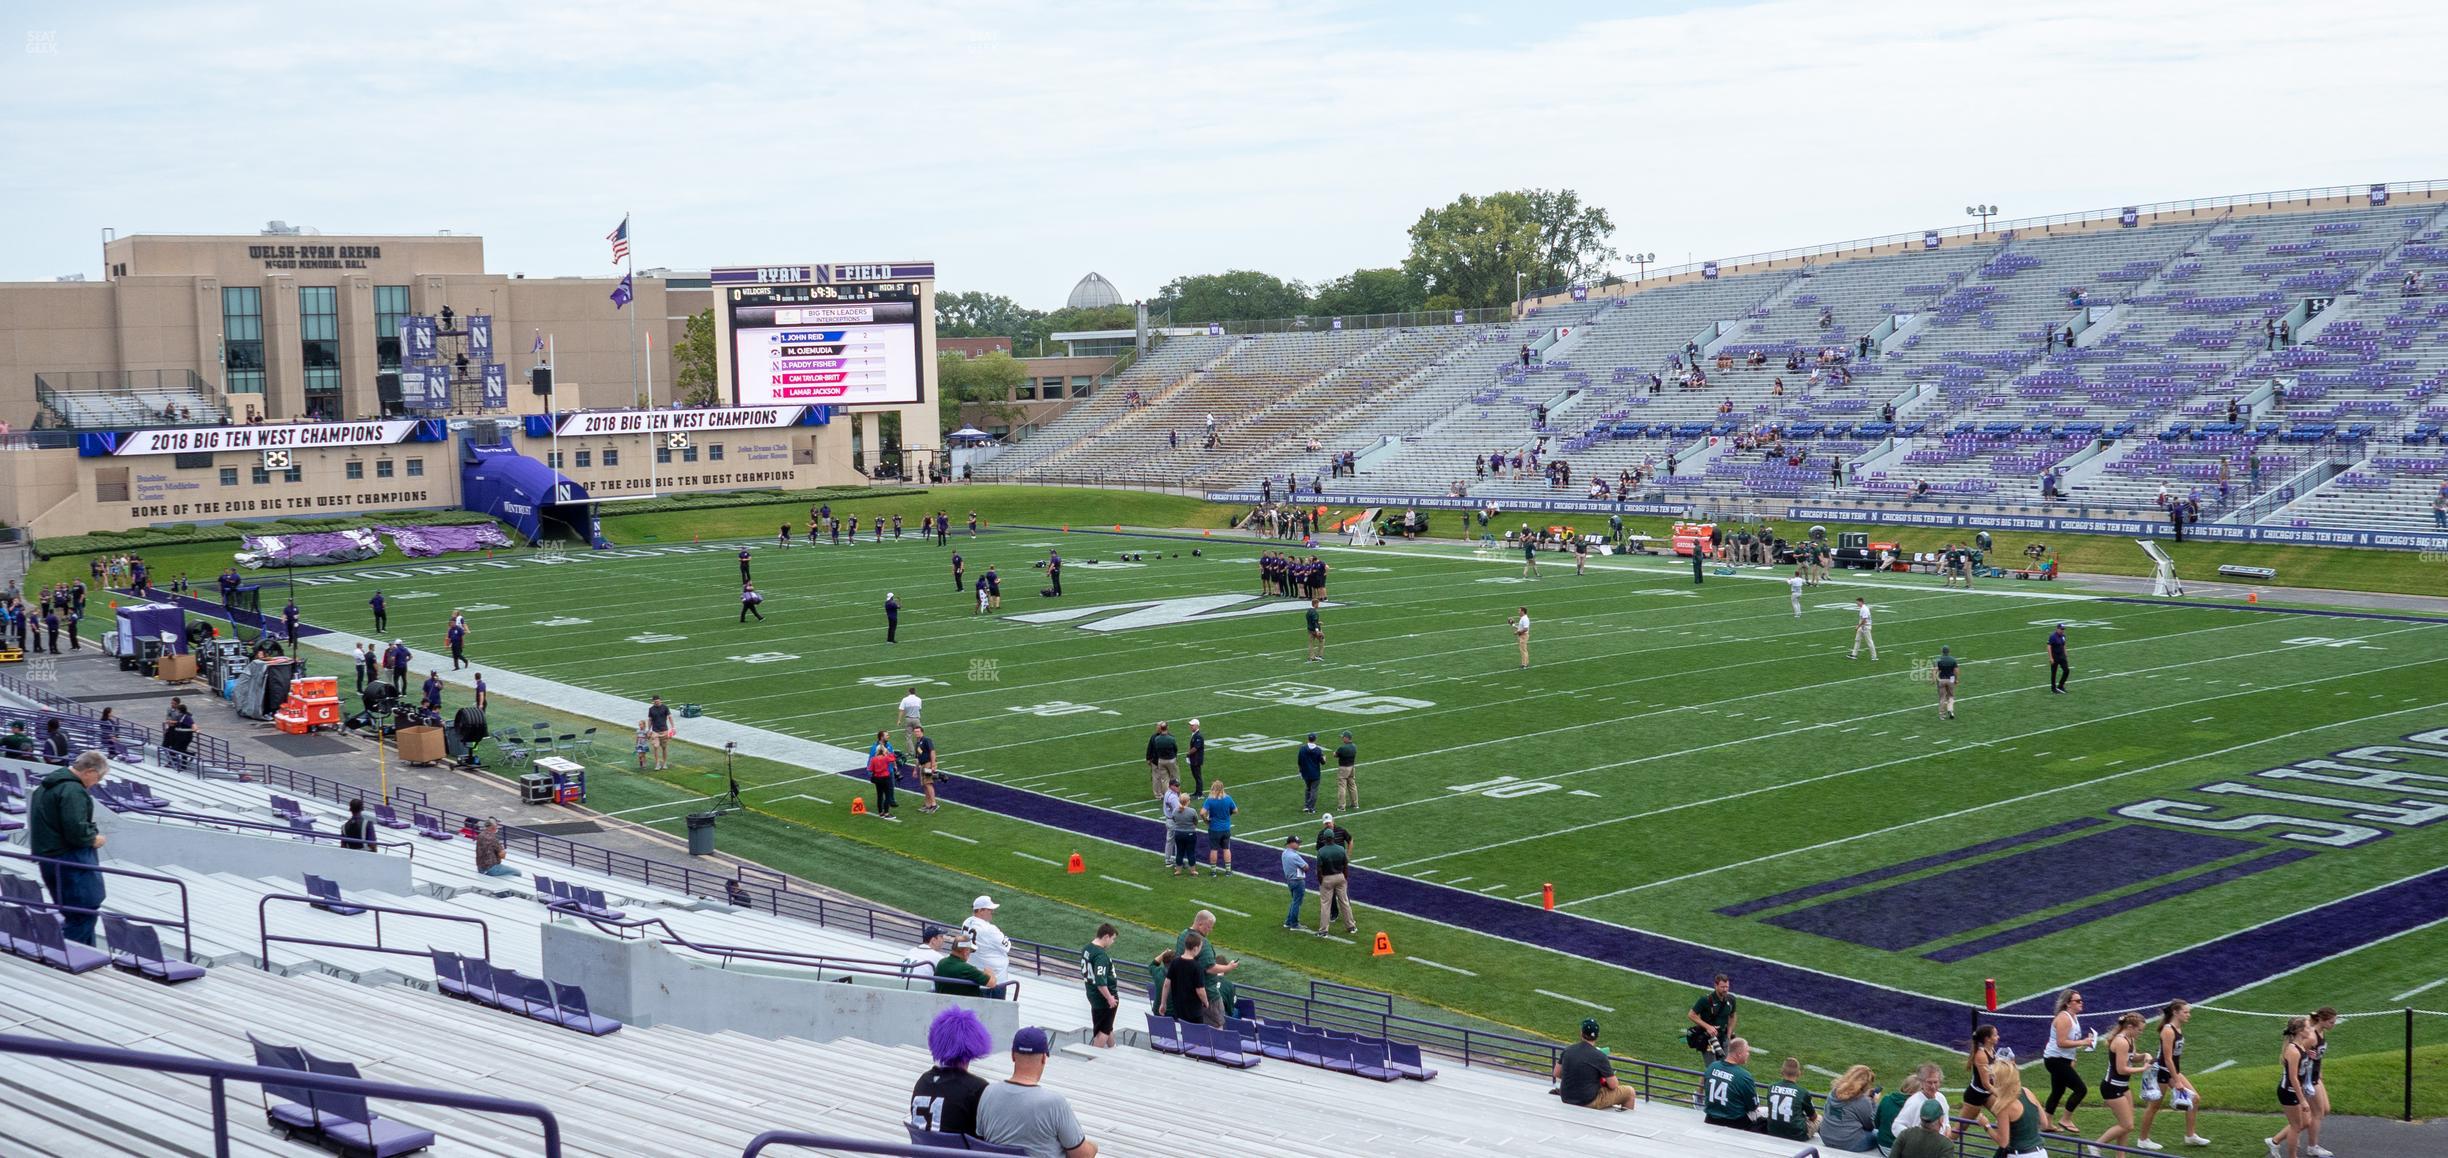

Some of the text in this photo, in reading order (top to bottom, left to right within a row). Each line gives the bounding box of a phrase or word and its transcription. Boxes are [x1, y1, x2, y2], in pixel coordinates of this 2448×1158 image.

[2371, 191, 2385, 200] 108
[2124, 213, 2136, 222] 107
[248, 246, 381, 259] WELSH-RYAN ARENA
[299, 260, 343, 269] MEMORIAL
[345, 260, 368, 269] HALL
[757, 267, 801, 283] RYAN
[817, 265, 829, 284] N
[845, 265, 892, 281] FIELD
[734, 289, 741, 300] 0
[912, 284, 920, 295] 0
[1574, 290, 1585, 298] 104
[415, 327, 431, 349] N
[472, 326, 488, 348] N
[813, 360, 837, 368] FISHER
[772, 375, 781, 384] N
[430, 376, 446, 399] N
[487, 376, 502, 398] N
[773, 389, 782, 398] N
[585, 410, 778, 432] 2018 BIG TEN WEST CHAMPIONS
[151, 425, 384, 451] 2018 BIG TEN WEST CHAMPIONS
[670, 433, 687, 447] 25
[266, 451, 289, 467] 25
[137, 482, 200, 492] Sports Medicine
[582, 471, 795, 491] OF THE 2018 BIG TEN WEST CHAMPIONS
[559, 484, 571, 501] N
[131, 491, 427, 518] HOME OF THE 2018 BIG TEN WEST CHAMPIONS
[1799, 510, 1828, 519] CHICAGO'S
[1828, 511, 1838, 519] BIG
[1839, 511, 1850, 520] TEN
[1851, 512, 1867, 520] TEAM
[1882, 513, 1911, 522] CHICAGO'S
[1912, 514, 1923, 522] BIG
[1924, 514, 1935, 523] TEN
[1936, 515, 1953, 524] TEAM
[1969, 516, 2000, 526] CHICAGO'S
[2000, 517, 2012, 527] BIG
[2012, 518, 2025, 527] TEN
[2026, 518, 2044, 528] TEAM
[2060, 520, 2094, 531] CHICAGO'S
[2094, 522, 2106, 531] BIG
[2106, 523, 2121, 532] TEN
[2121, 523, 2141, 533] TEAM
[2195, 526, 2208, 536] BIG
[2208, 527, 2223, 536] TEN
[2224, 528, 2244, 537] TEAM
[2263, 529, 2301, 540] CHICAGO'S
[2301, 531, 2315, 541] BIG
[2316, 532, 2331, 542] TEN
[2332, 532, 2354, 543] TEAM
[2360, 533, 2368, 544] N
[2374, 534, 2416, 546] CHICAGO'S
[1001, 594, 1346, 632] N
[319, 707, 329, 718] G
[1005, 701, 1100, 716] 30
[1203, 733, 1303, 753] 20
[1446, 776, 1562, 798] 10
[853, 802, 864, 812] 20
[1072, 858, 1081, 866] 10
[1377, 937, 1387, 950] G
[1709, 1078, 1728, 1106] 14
[911, 1096, 945, 1132] 51
[1769, 1094, 1793, 1122] 14
